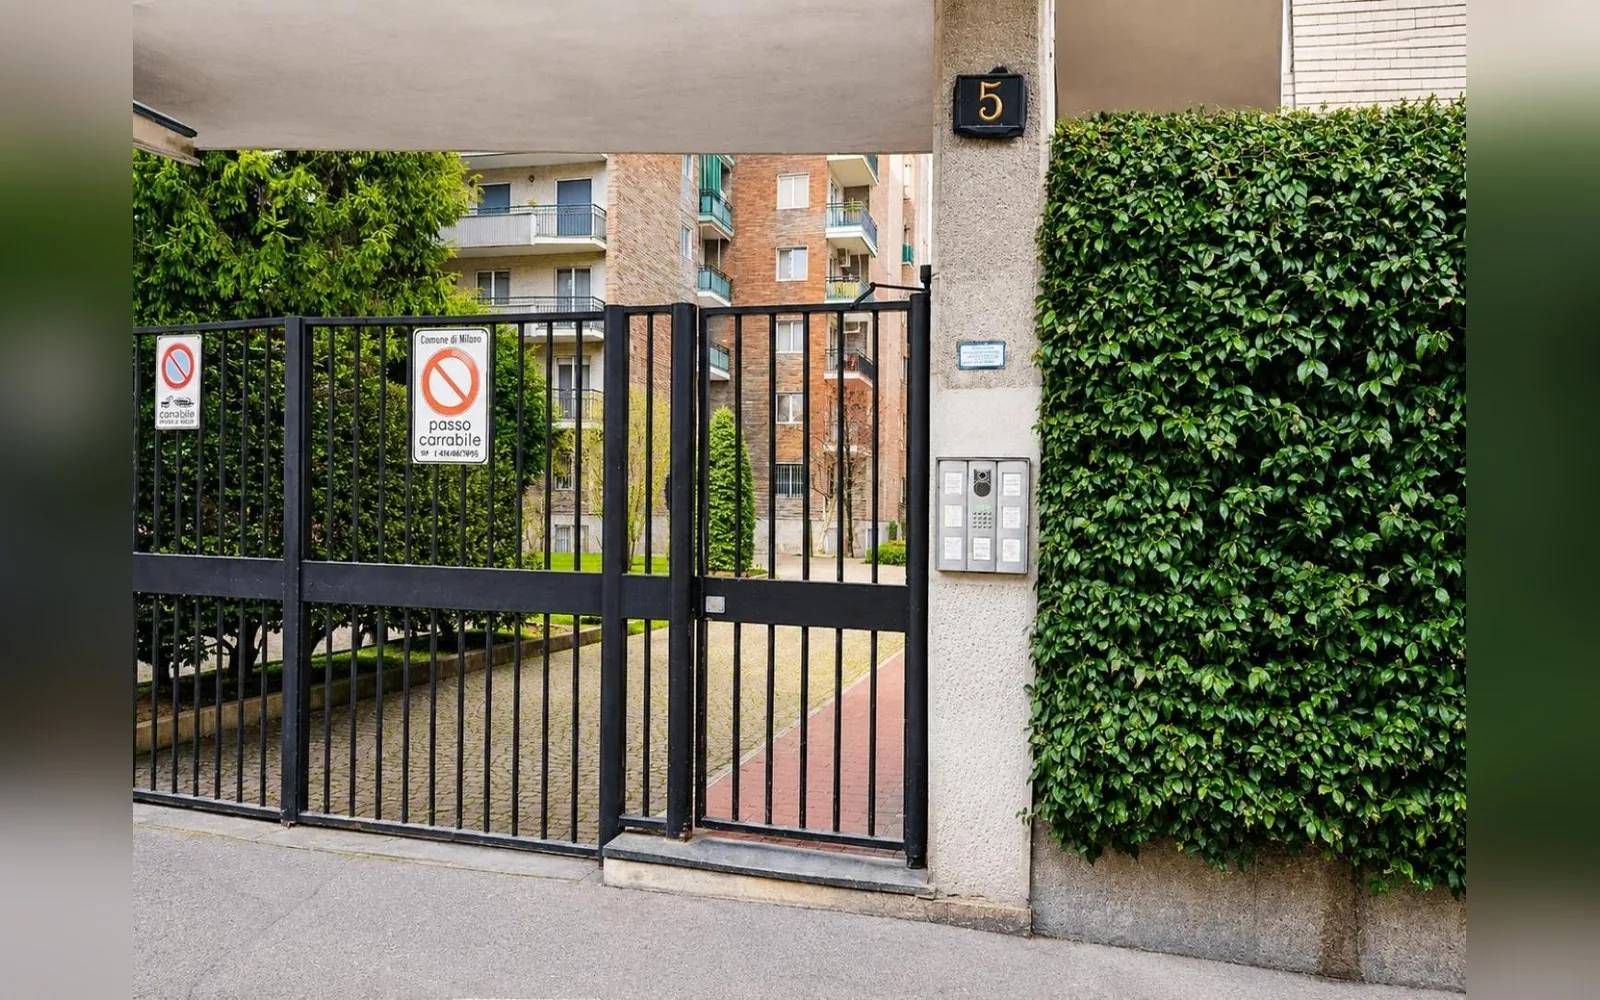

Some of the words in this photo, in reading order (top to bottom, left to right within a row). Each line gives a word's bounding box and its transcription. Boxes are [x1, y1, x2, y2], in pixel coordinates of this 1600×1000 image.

[979, 80, 1003, 122] 5
[420, 335, 449, 345] Comune
[450, 335, 457, 345] di
[459, 334, 482, 344] Milano
[429, 420, 471, 434] passo
[419, 433, 481, 447] carrabile
